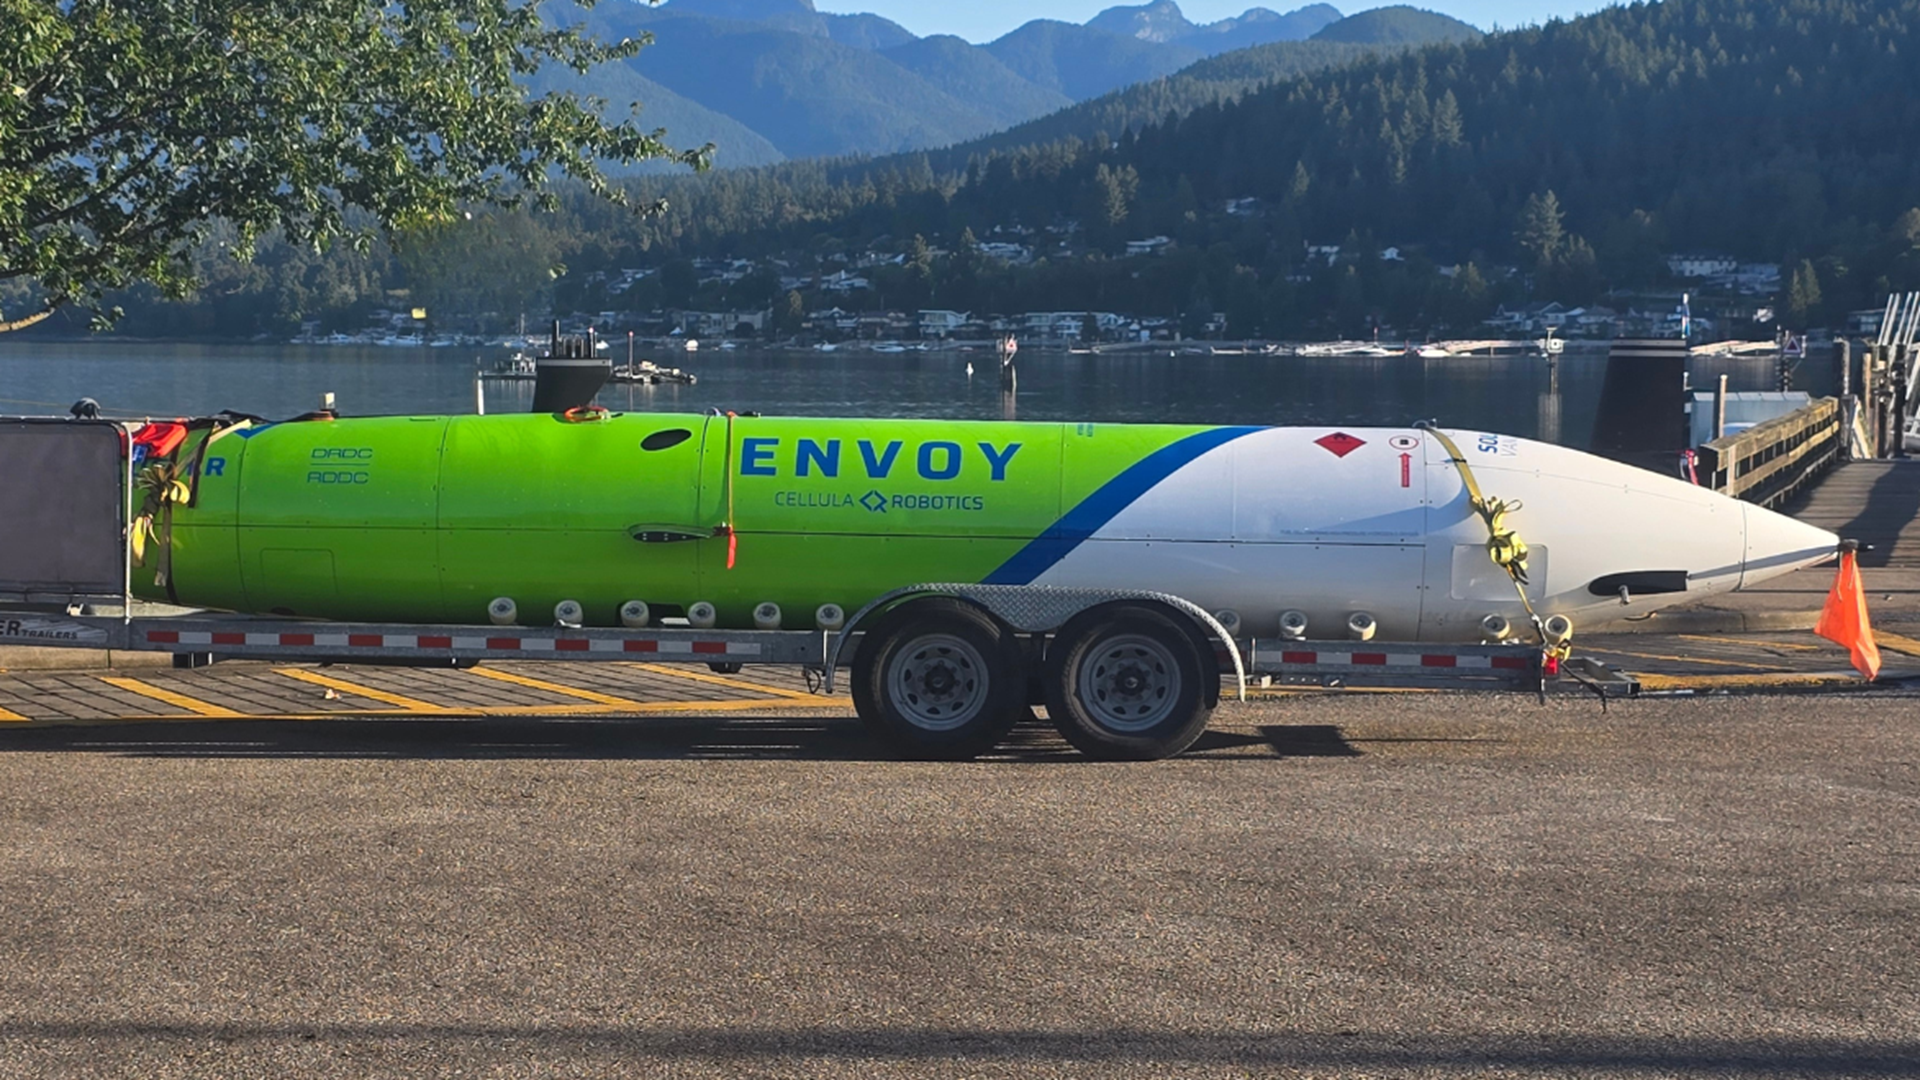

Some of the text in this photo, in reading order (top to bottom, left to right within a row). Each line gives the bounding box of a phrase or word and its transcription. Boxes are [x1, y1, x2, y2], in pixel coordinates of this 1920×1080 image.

[311, 448, 373, 459] DRDC
[740, 437, 1023, 481] ENVOY
[307, 471, 369, 484] RDDC
[775, 491, 984, 511] CELLULA ROBOTICS
[21, 629, 78, 640] TRAILERS
